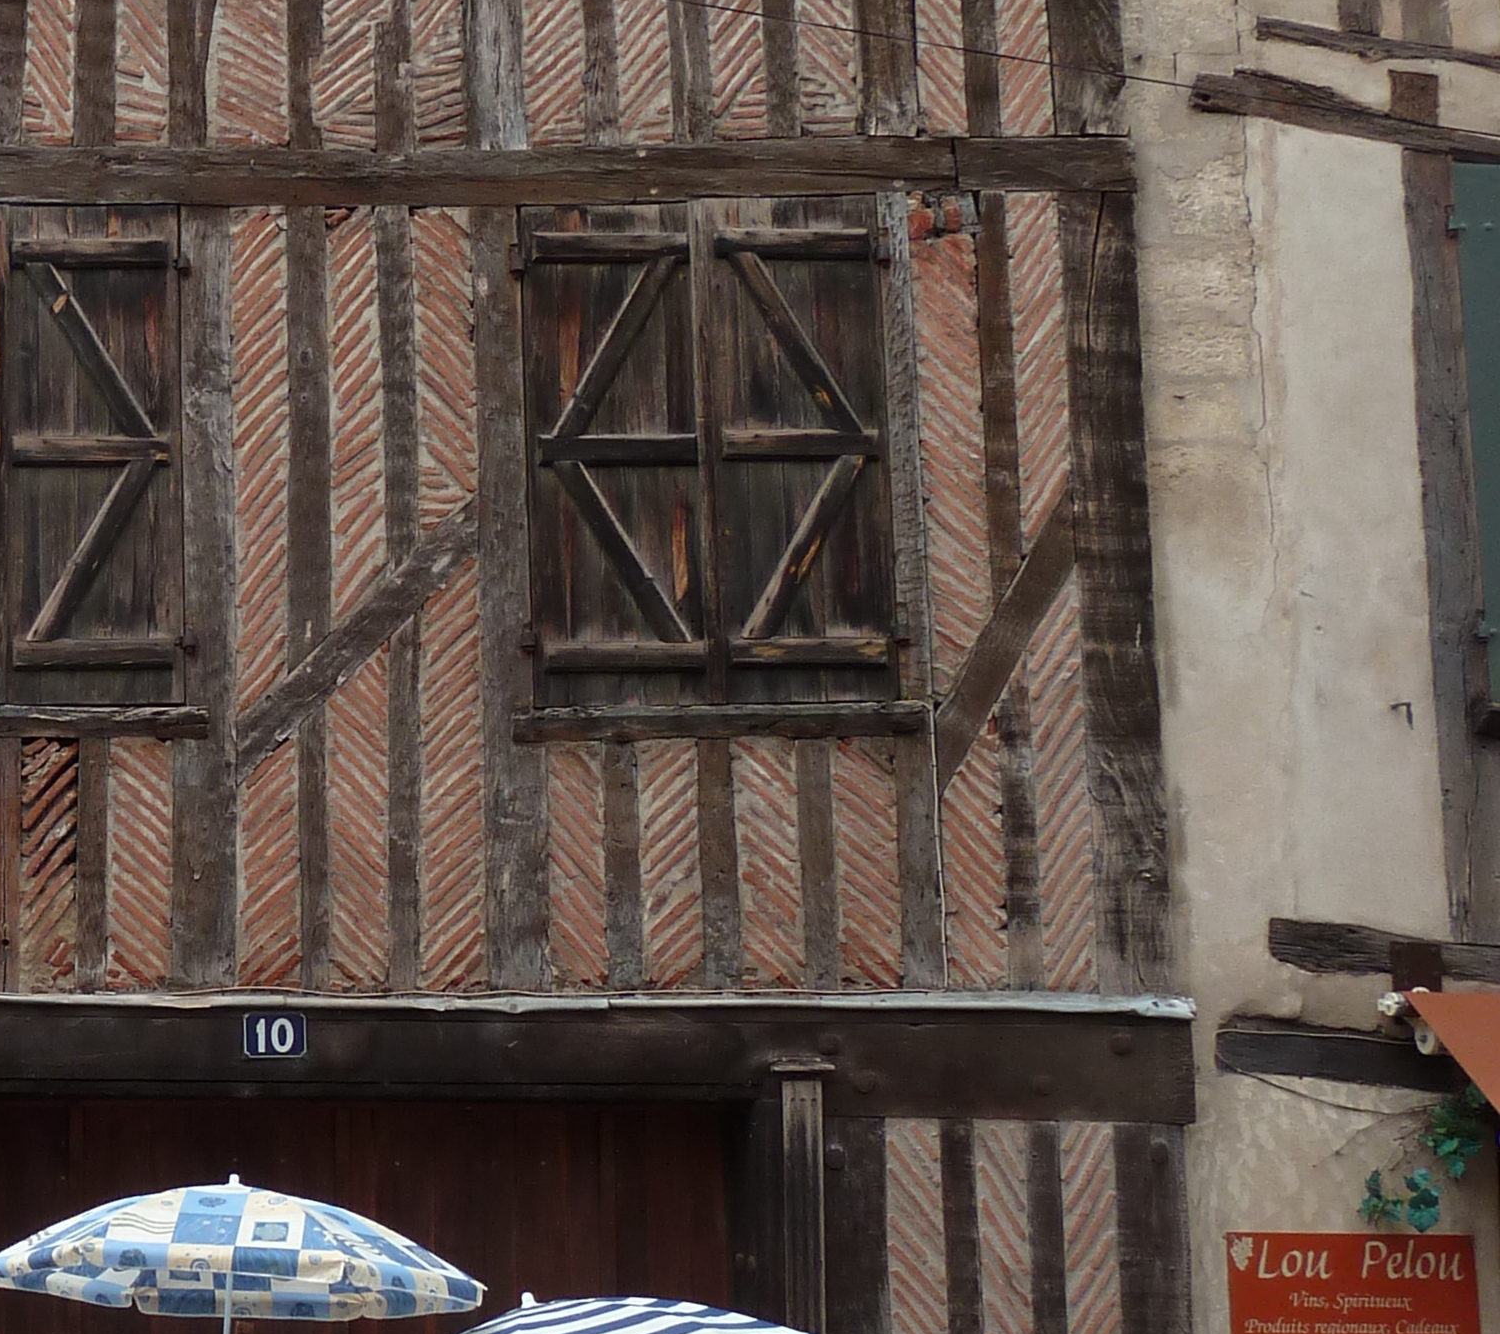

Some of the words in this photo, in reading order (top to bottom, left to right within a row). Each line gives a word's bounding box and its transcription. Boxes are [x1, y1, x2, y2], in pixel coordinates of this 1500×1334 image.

[255, 1017, 295, 1054] 10
[1258, 1240, 1333, 1280] Lou
[1361, 1239, 1466, 1281] Pelou
[1289, 1291, 1330, 1309] Vins,
[1333, 1291, 1414, 1314] Spiritueux
[1244, 1317, 1310, 1334] Produits
